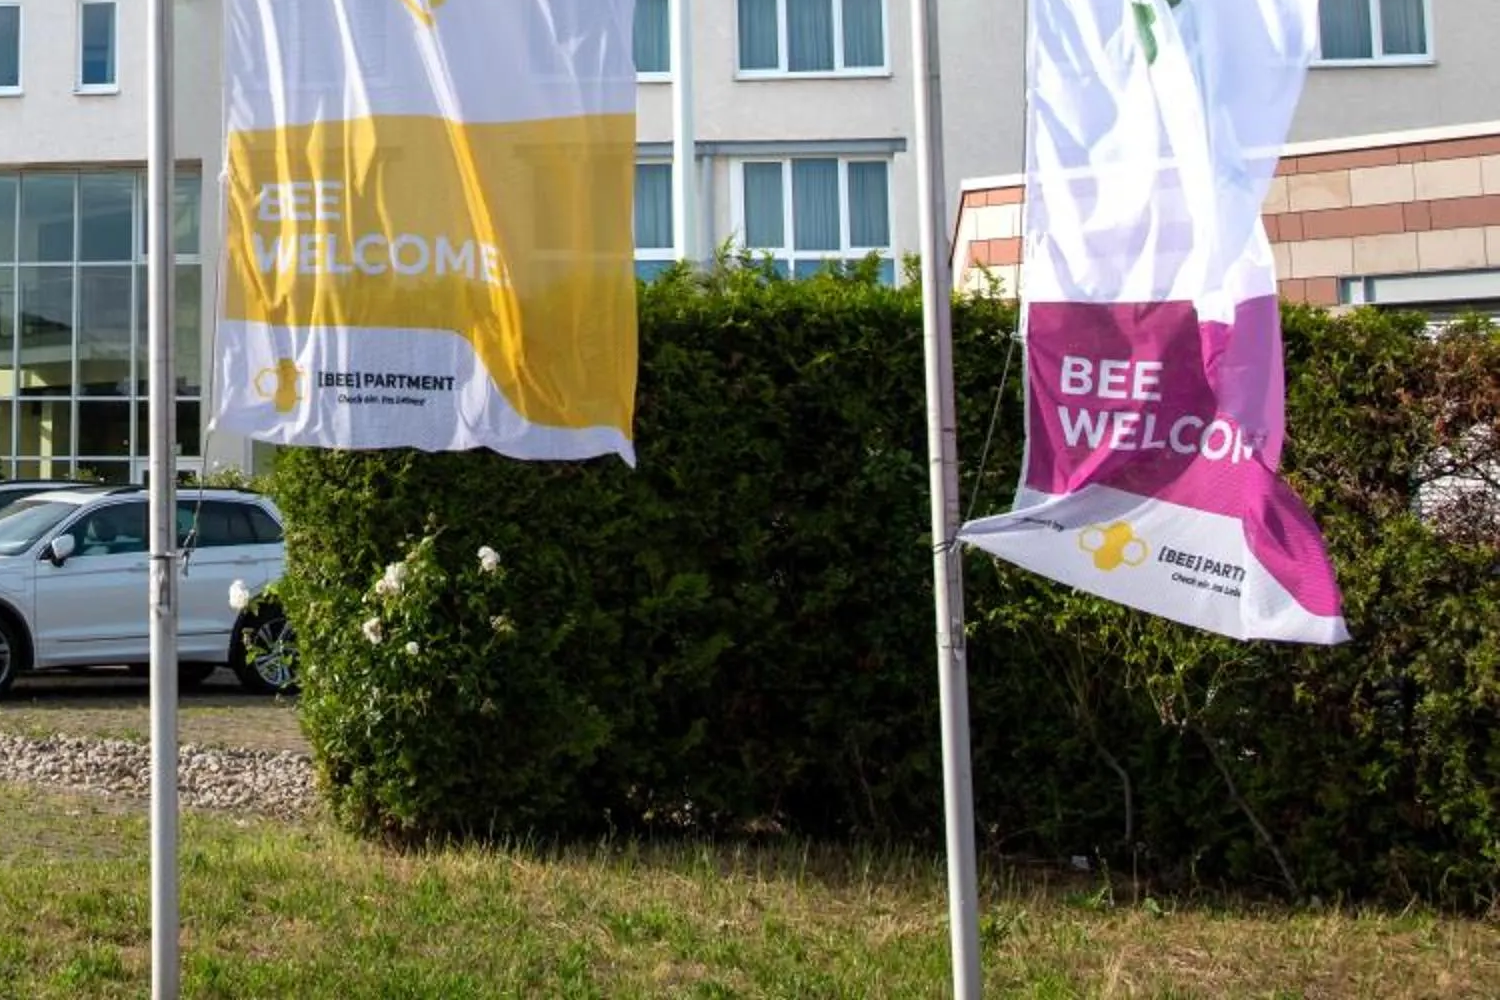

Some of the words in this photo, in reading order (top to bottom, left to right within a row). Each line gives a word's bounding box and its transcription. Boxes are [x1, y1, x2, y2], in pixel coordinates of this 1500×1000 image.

[258, 180, 343, 222] BEE
[317, 371, 361, 389] [BEE]
[363, 373, 455, 391] PARTMENT
[1059, 355, 1164, 402] BEE
